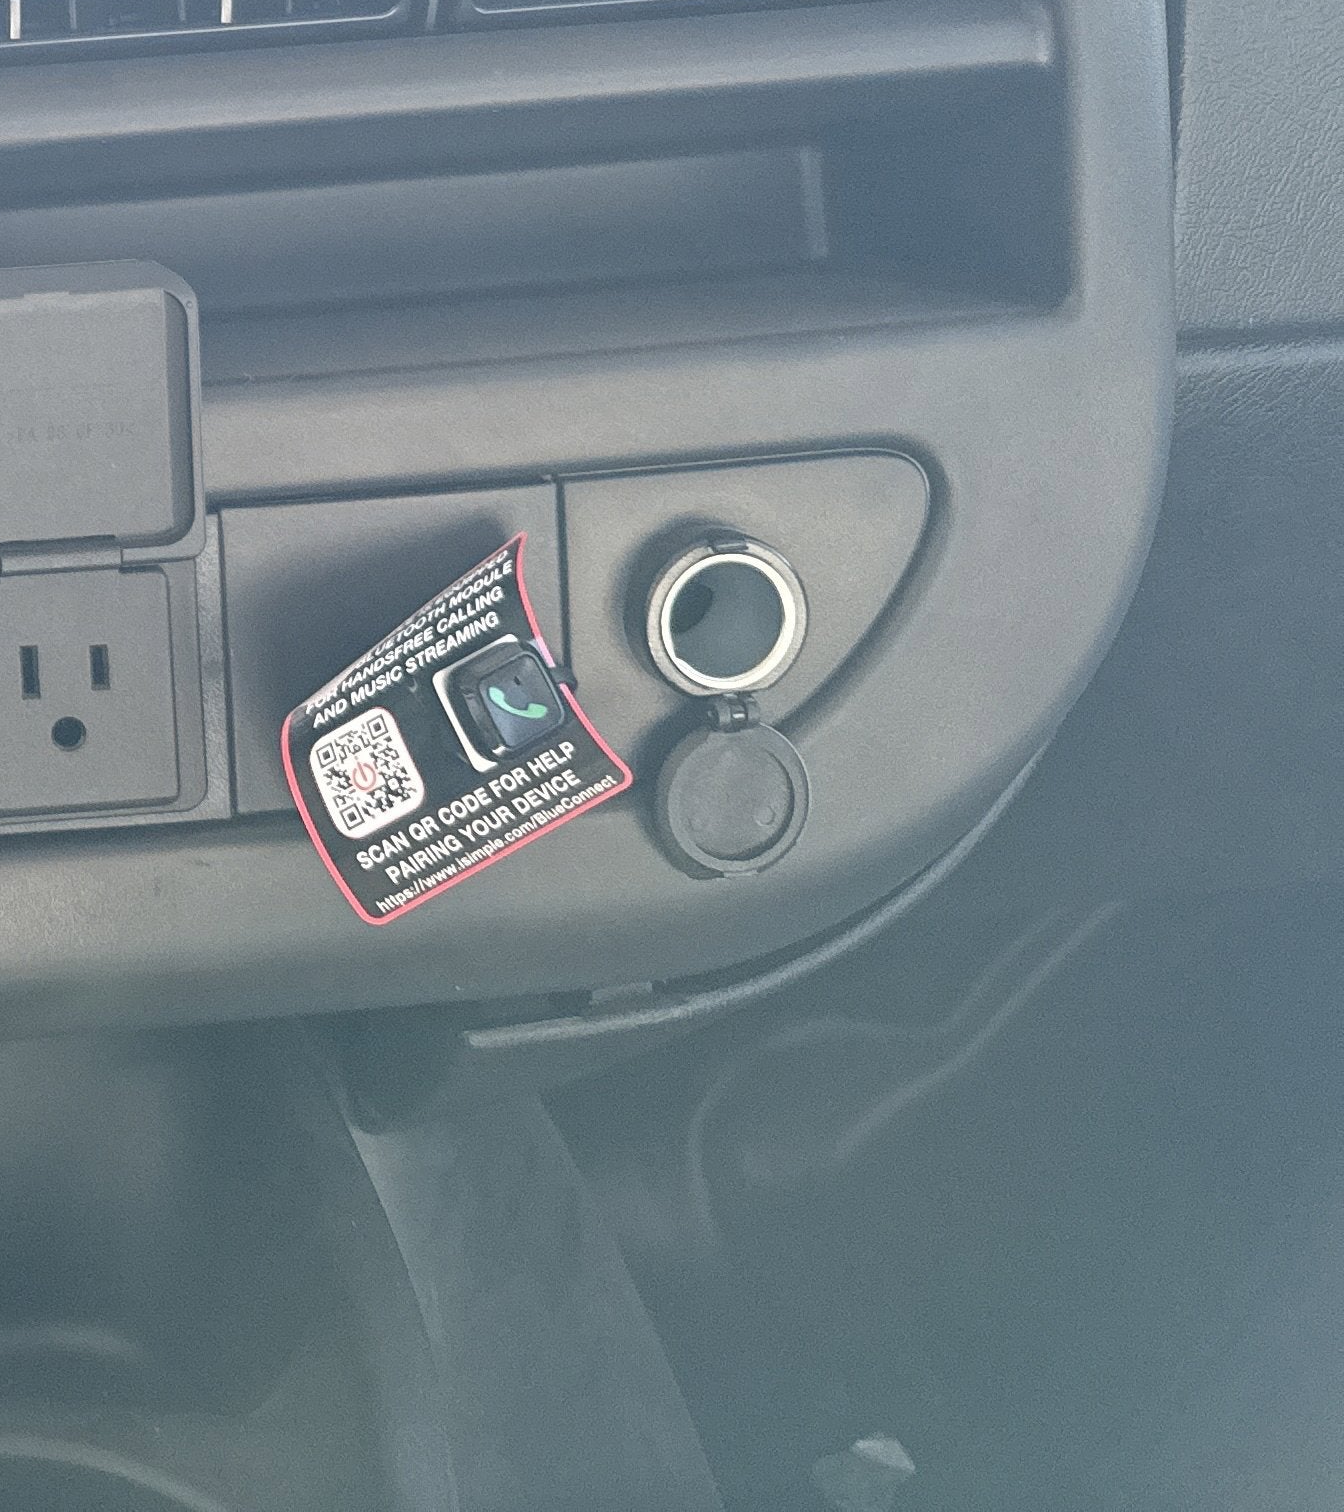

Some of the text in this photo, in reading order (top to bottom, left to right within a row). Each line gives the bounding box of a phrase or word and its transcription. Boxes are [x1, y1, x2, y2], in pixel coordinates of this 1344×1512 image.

[341, 625, 434, 693] HANDSFREE
[436, 584, 505, 635] CALLING
[448, 559, 513, 609] MODULE
[313, 611, 501, 729] AND MUSIC STREAMING
[355, 740, 576, 872] SCAN QR CODE FOR HELP
[384, 768, 582, 886] PAIRING YOUR DEVICE
